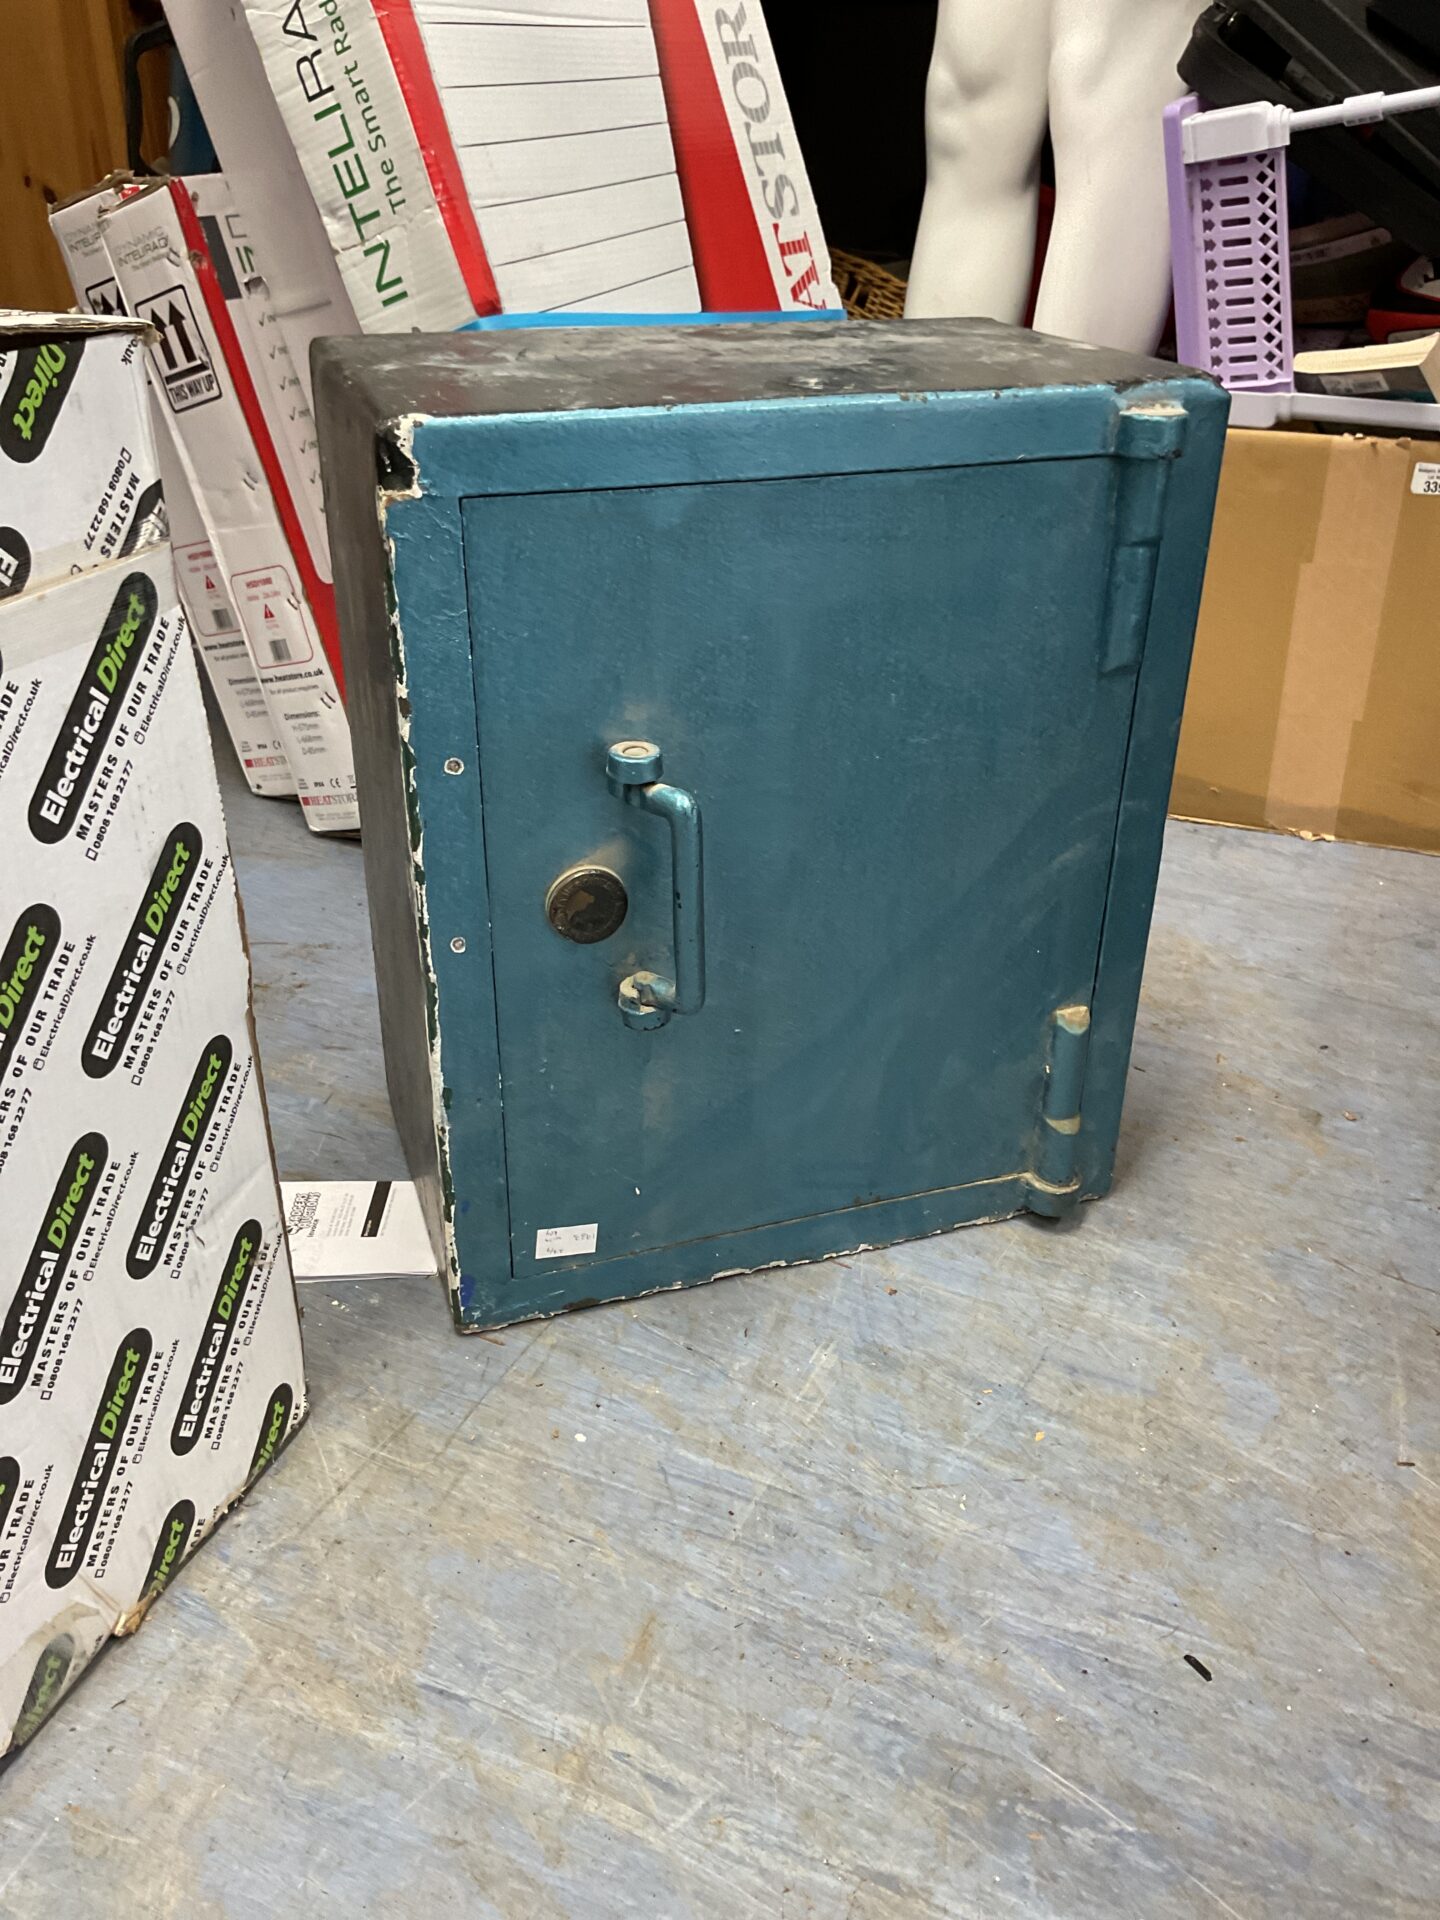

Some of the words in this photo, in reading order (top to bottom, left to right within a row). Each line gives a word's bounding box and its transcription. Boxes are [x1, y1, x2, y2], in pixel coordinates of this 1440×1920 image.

[343, 60, 387, 153] Smart
[380, 158, 406, 216] The
[714, 1, 827, 310] ATSTOR
[13, 344, 67, 440] Direct
[169, 383, 189, 404] THIS
[184, 376, 205, 398] WAY
[201, 373, 215, 392] UP
[101, 473, 141, 559] MASTERS
[109, 460, 128, 491] 0808
[1423, 480, 1440, 493] 33
[0, 681, 19, 729] ADE
[0, 679, 41, 778] calDirect.co.uk
[40, 687, 109, 824] Electrical
[97, 594, 144, 693] Direct
[76, 755, 117, 840] MASTERS
[115, 724, 129, 747] OF
[127, 682, 146, 717] OUR
[144, 617, 169, 674] TRADE
[93, 819, 110, 848] 0808
[138, 616, 187, 732] ElectricalDirect.co.uk
[13, 1055, 27, 1077] OF
[26, 1010, 47, 1046] OUR
[43, 942, 75, 1000] TRADE
[40, 935, 96, 1057] ElectricalDirect.co.uk
[92, 933, 155, 1059] Electrical
[145, 842, 190, 933] Direct
[124, 989, 161, 1069] MASTERS
[160, 960, 172, 980] OF
[171, 920, 189, 952] OUR
[187, 859, 213, 911] TRADE
[138, 1047, 153, 1074] 0808
[182, 853, 229, 963] ElectricalDirect.co.uk
[136, 1141, 191, 1260] Electrical
[182, 1055, 221, 1139] Direct
[164, 1190, 196, 1265] MASTERS
[195, 1161, 206, 1180] OF
[205, 1122, 221, 1152] OUR
[219, 1063, 241, 1112] TRADE
[0, 1251, 59, 1383] Electrical
[48, 1153, 94, 1248] Direct
[31, 1302, 68, 1386] MASTERS
[66, 1270, 78, 1291] OF
[76, 1227, 95, 1260] OUR
[92, 1162, 120, 1216] TRADE
[48, 1359, 62, 1388] 0808
[89, 1152, 138, 1268] ElectricalDirect.co.uk
[177, 1242, 189, 1268] 0808
[179, 1323, 226, 1437] Electrical
[218, 1239, 252, 1319] Direct
[101, 1538, 114, 1566] 0808
[138, 1340, 179, 1451] ElectricalDirect.co.uk
[205, 1365, 232, 1438] MASTERS
[231, 1338, 240, 1355] OF
[239, 1300, 253, 1328] OUR
[217, 1414, 227, 1440] 0808
[5, 1465, 53, 1589] ElectricalDirect.co.uk
[6, 1480, 34, 1539] TRADE
[56, 1443, 111, 1568] Electrical
[100, 1349, 140, 1438] Direct
[87, 1486, 119, 1567] MASTERS
[117, 1456, 128, 1475] OF
[126, 1415, 142, 1446] OUR
[140, 1352, 163, 1404] TRADE
